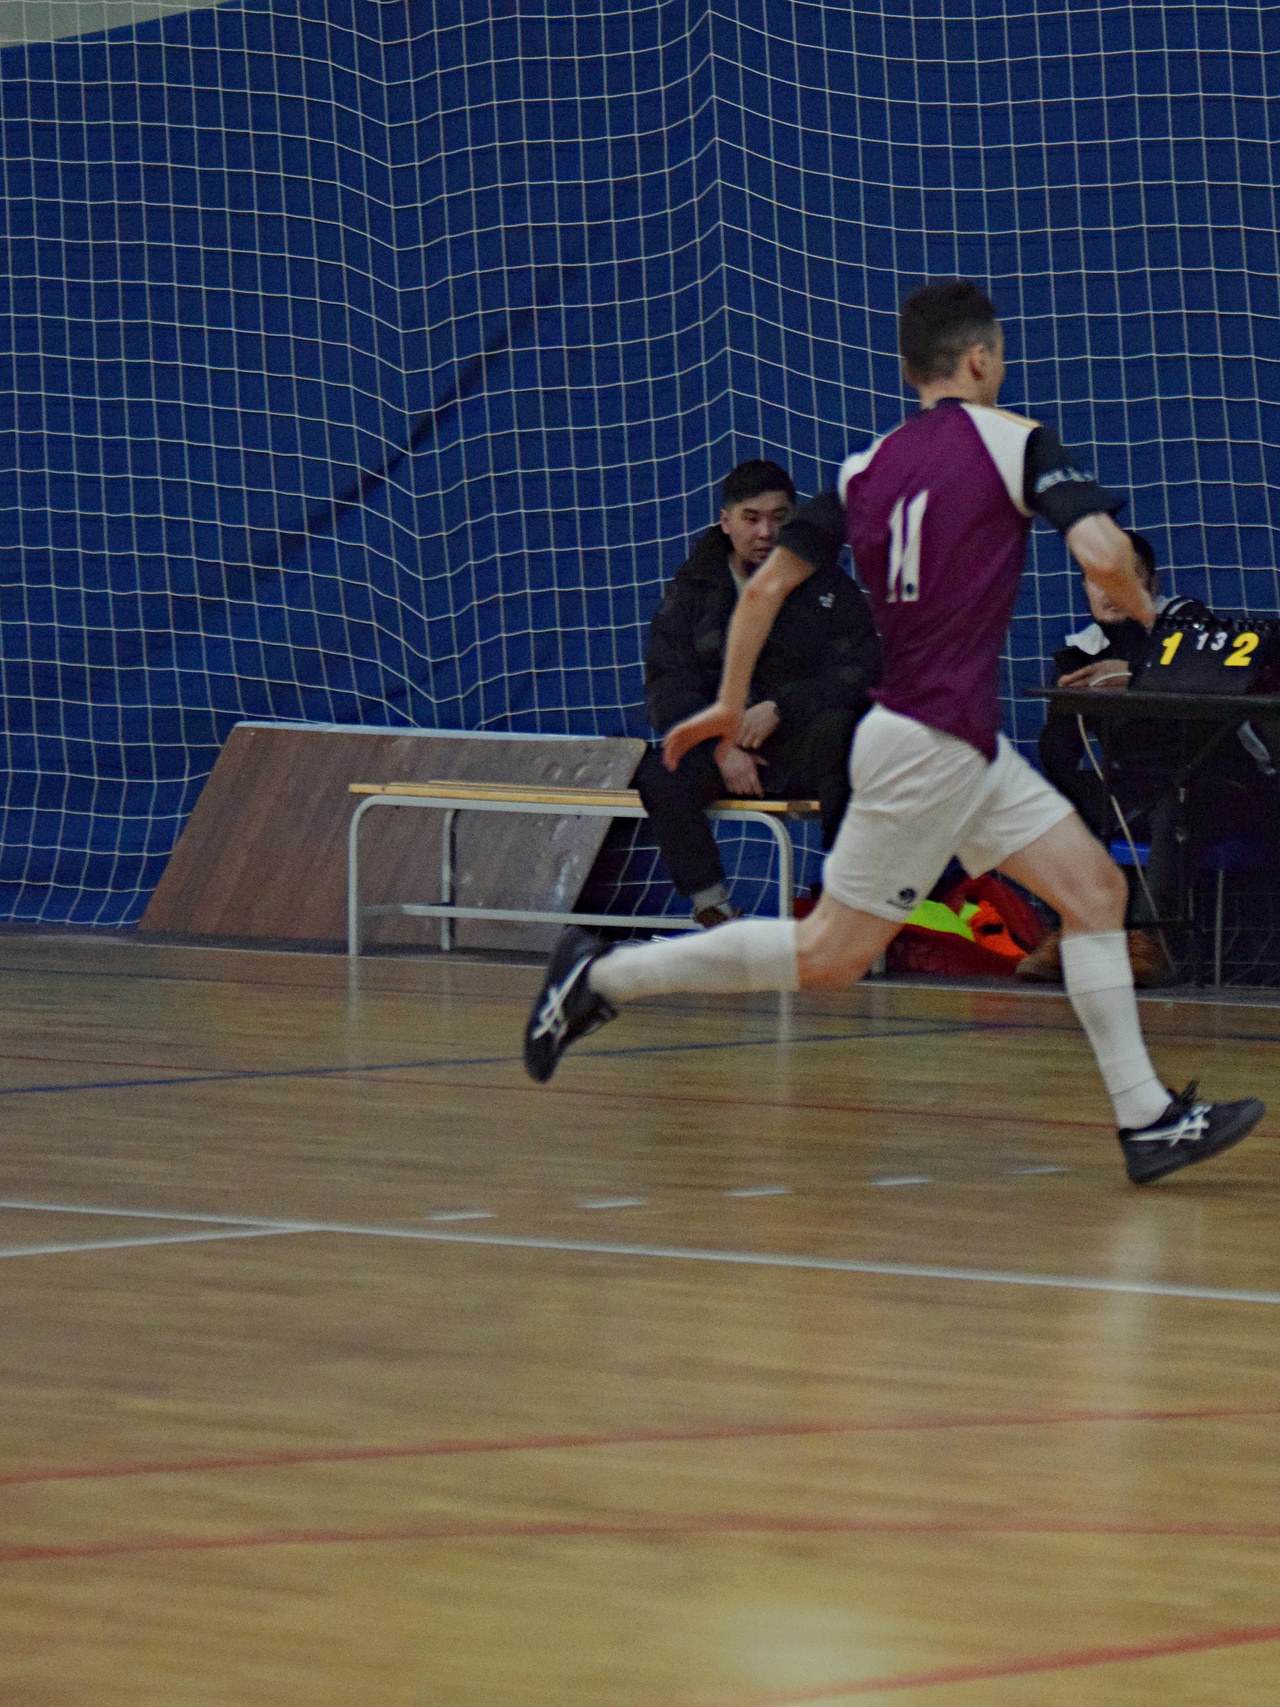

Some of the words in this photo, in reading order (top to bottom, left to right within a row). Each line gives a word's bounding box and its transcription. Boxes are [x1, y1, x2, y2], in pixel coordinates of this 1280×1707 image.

[886, 490, 929, 603] 11
[1159, 632, 1183, 665] 1
[1224, 632, 1259, 666] 2
